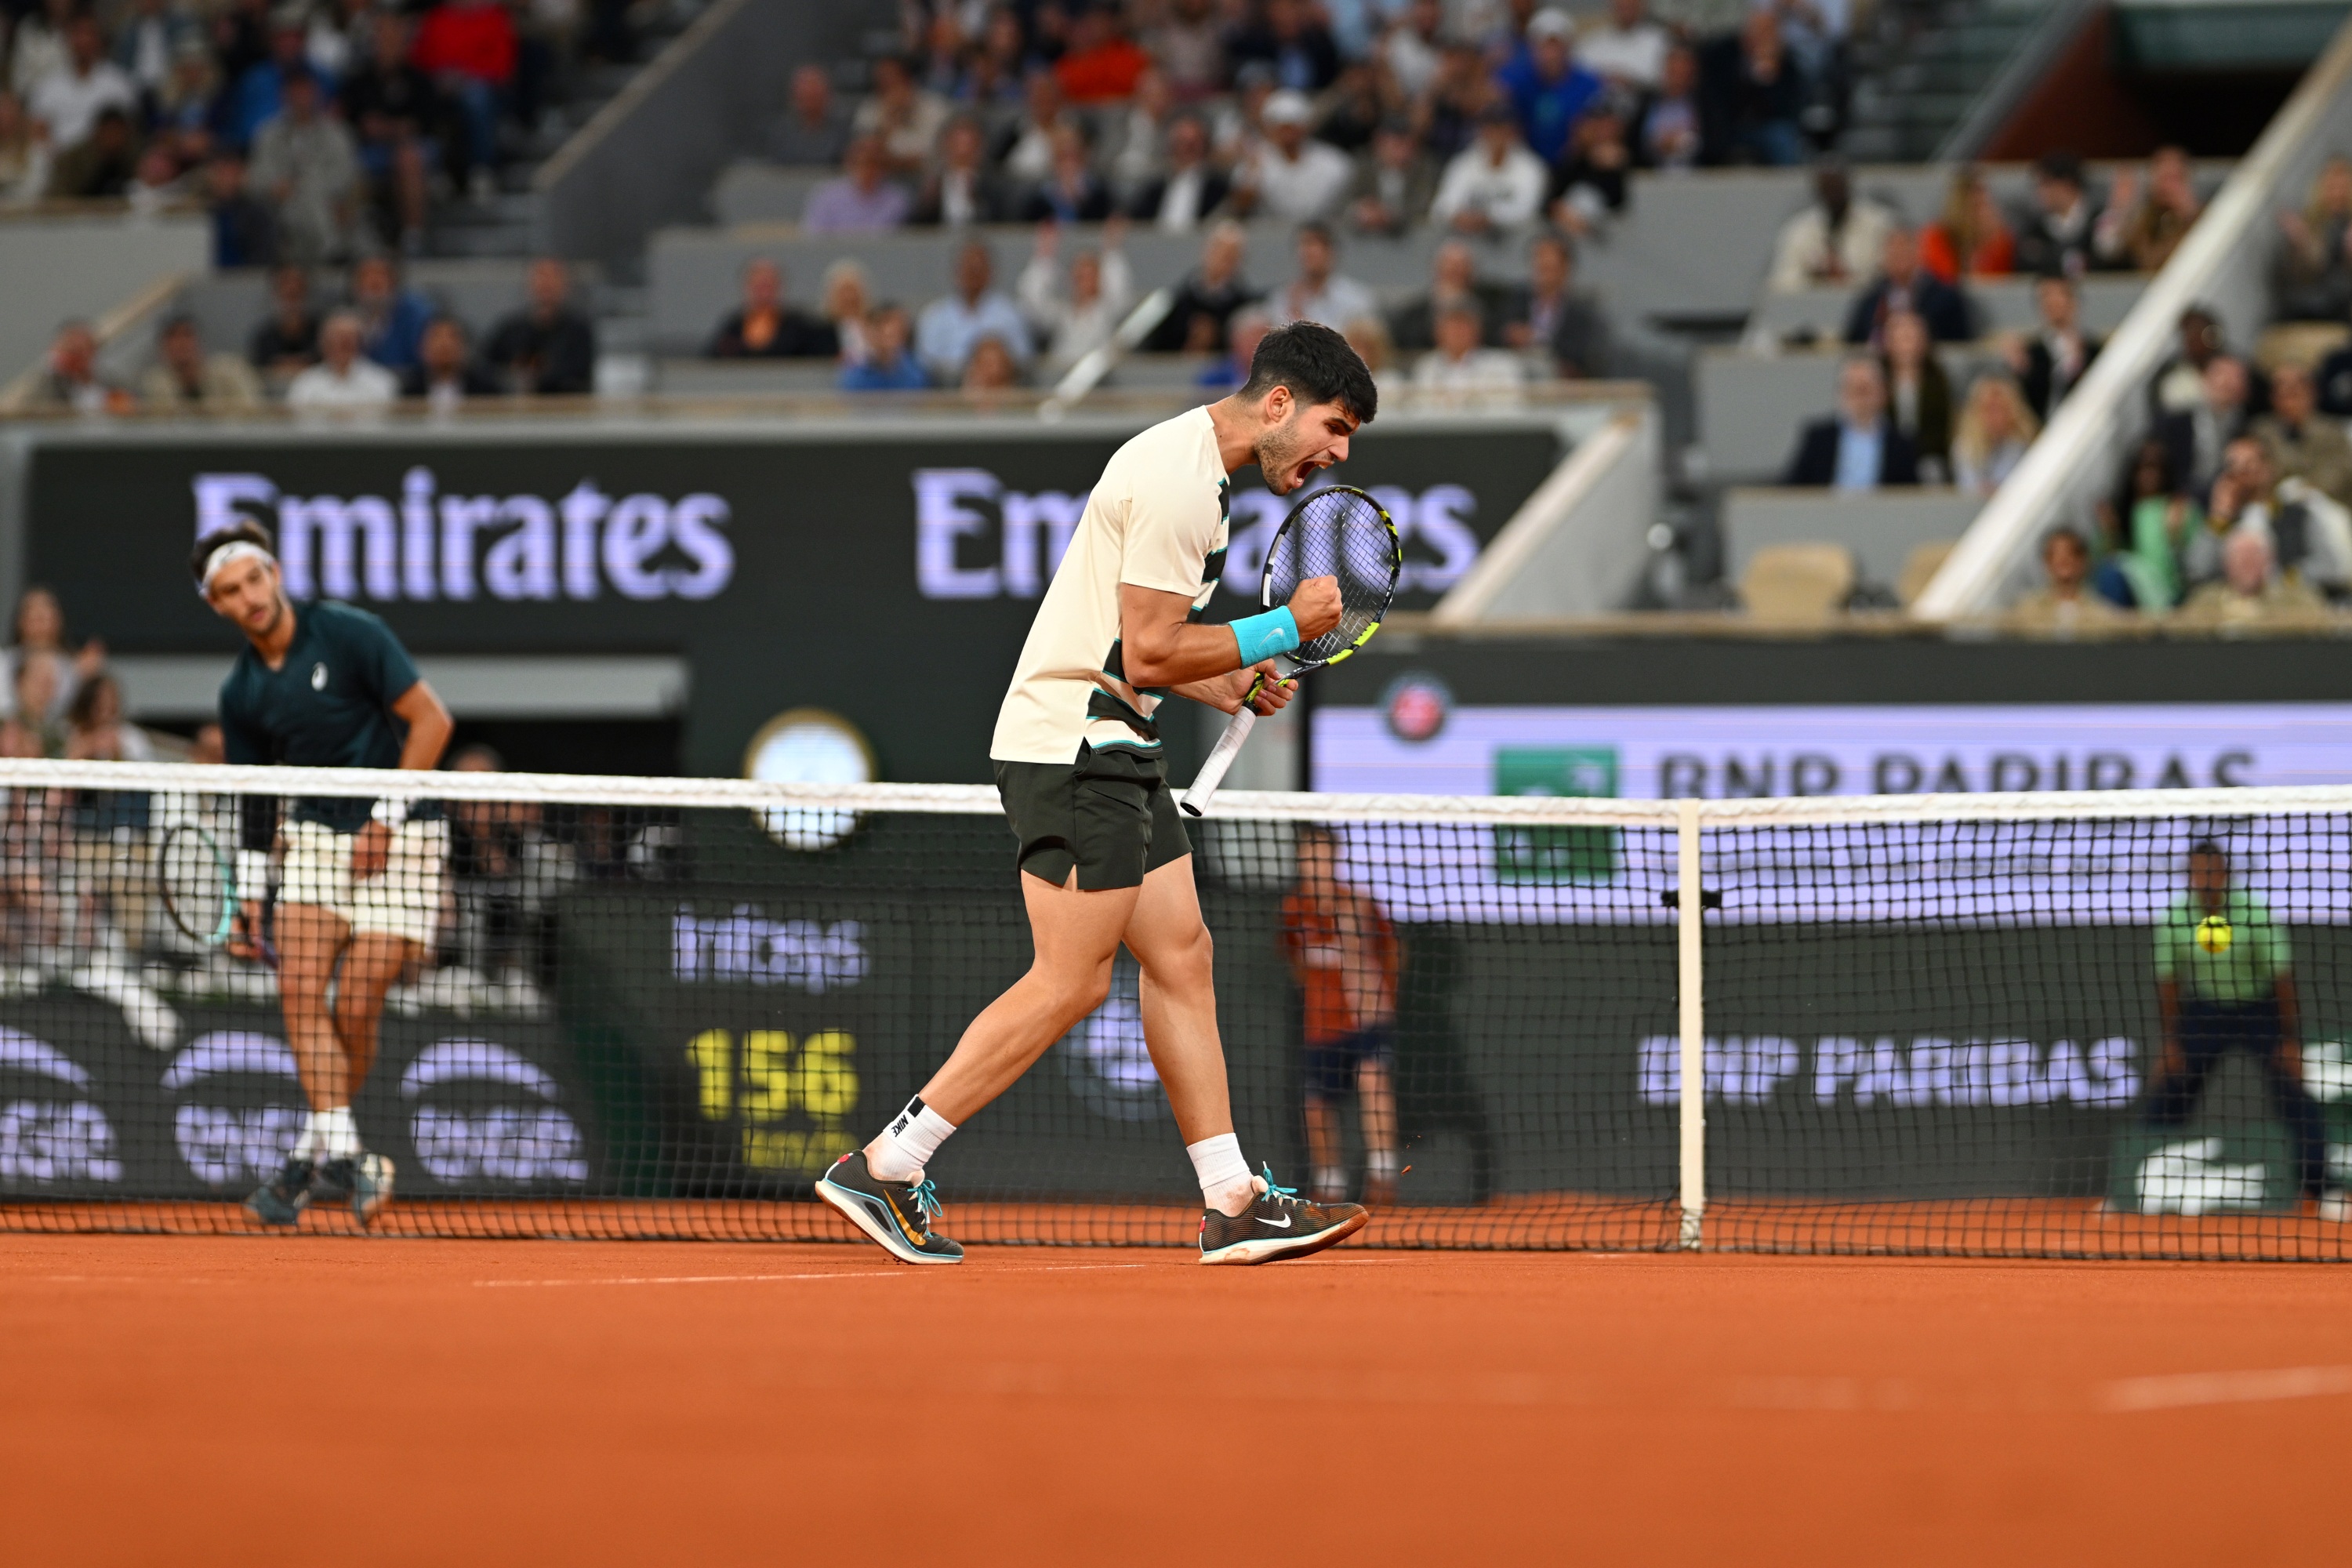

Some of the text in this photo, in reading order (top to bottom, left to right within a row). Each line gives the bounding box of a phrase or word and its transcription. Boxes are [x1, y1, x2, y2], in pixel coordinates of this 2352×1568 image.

[912, 468, 1479, 599] Emates
[686, 1027, 859, 1121] 156
[1812, 1033, 2142, 1107] PARIBAS
[891, 1114, 909, 1138] NIKE
